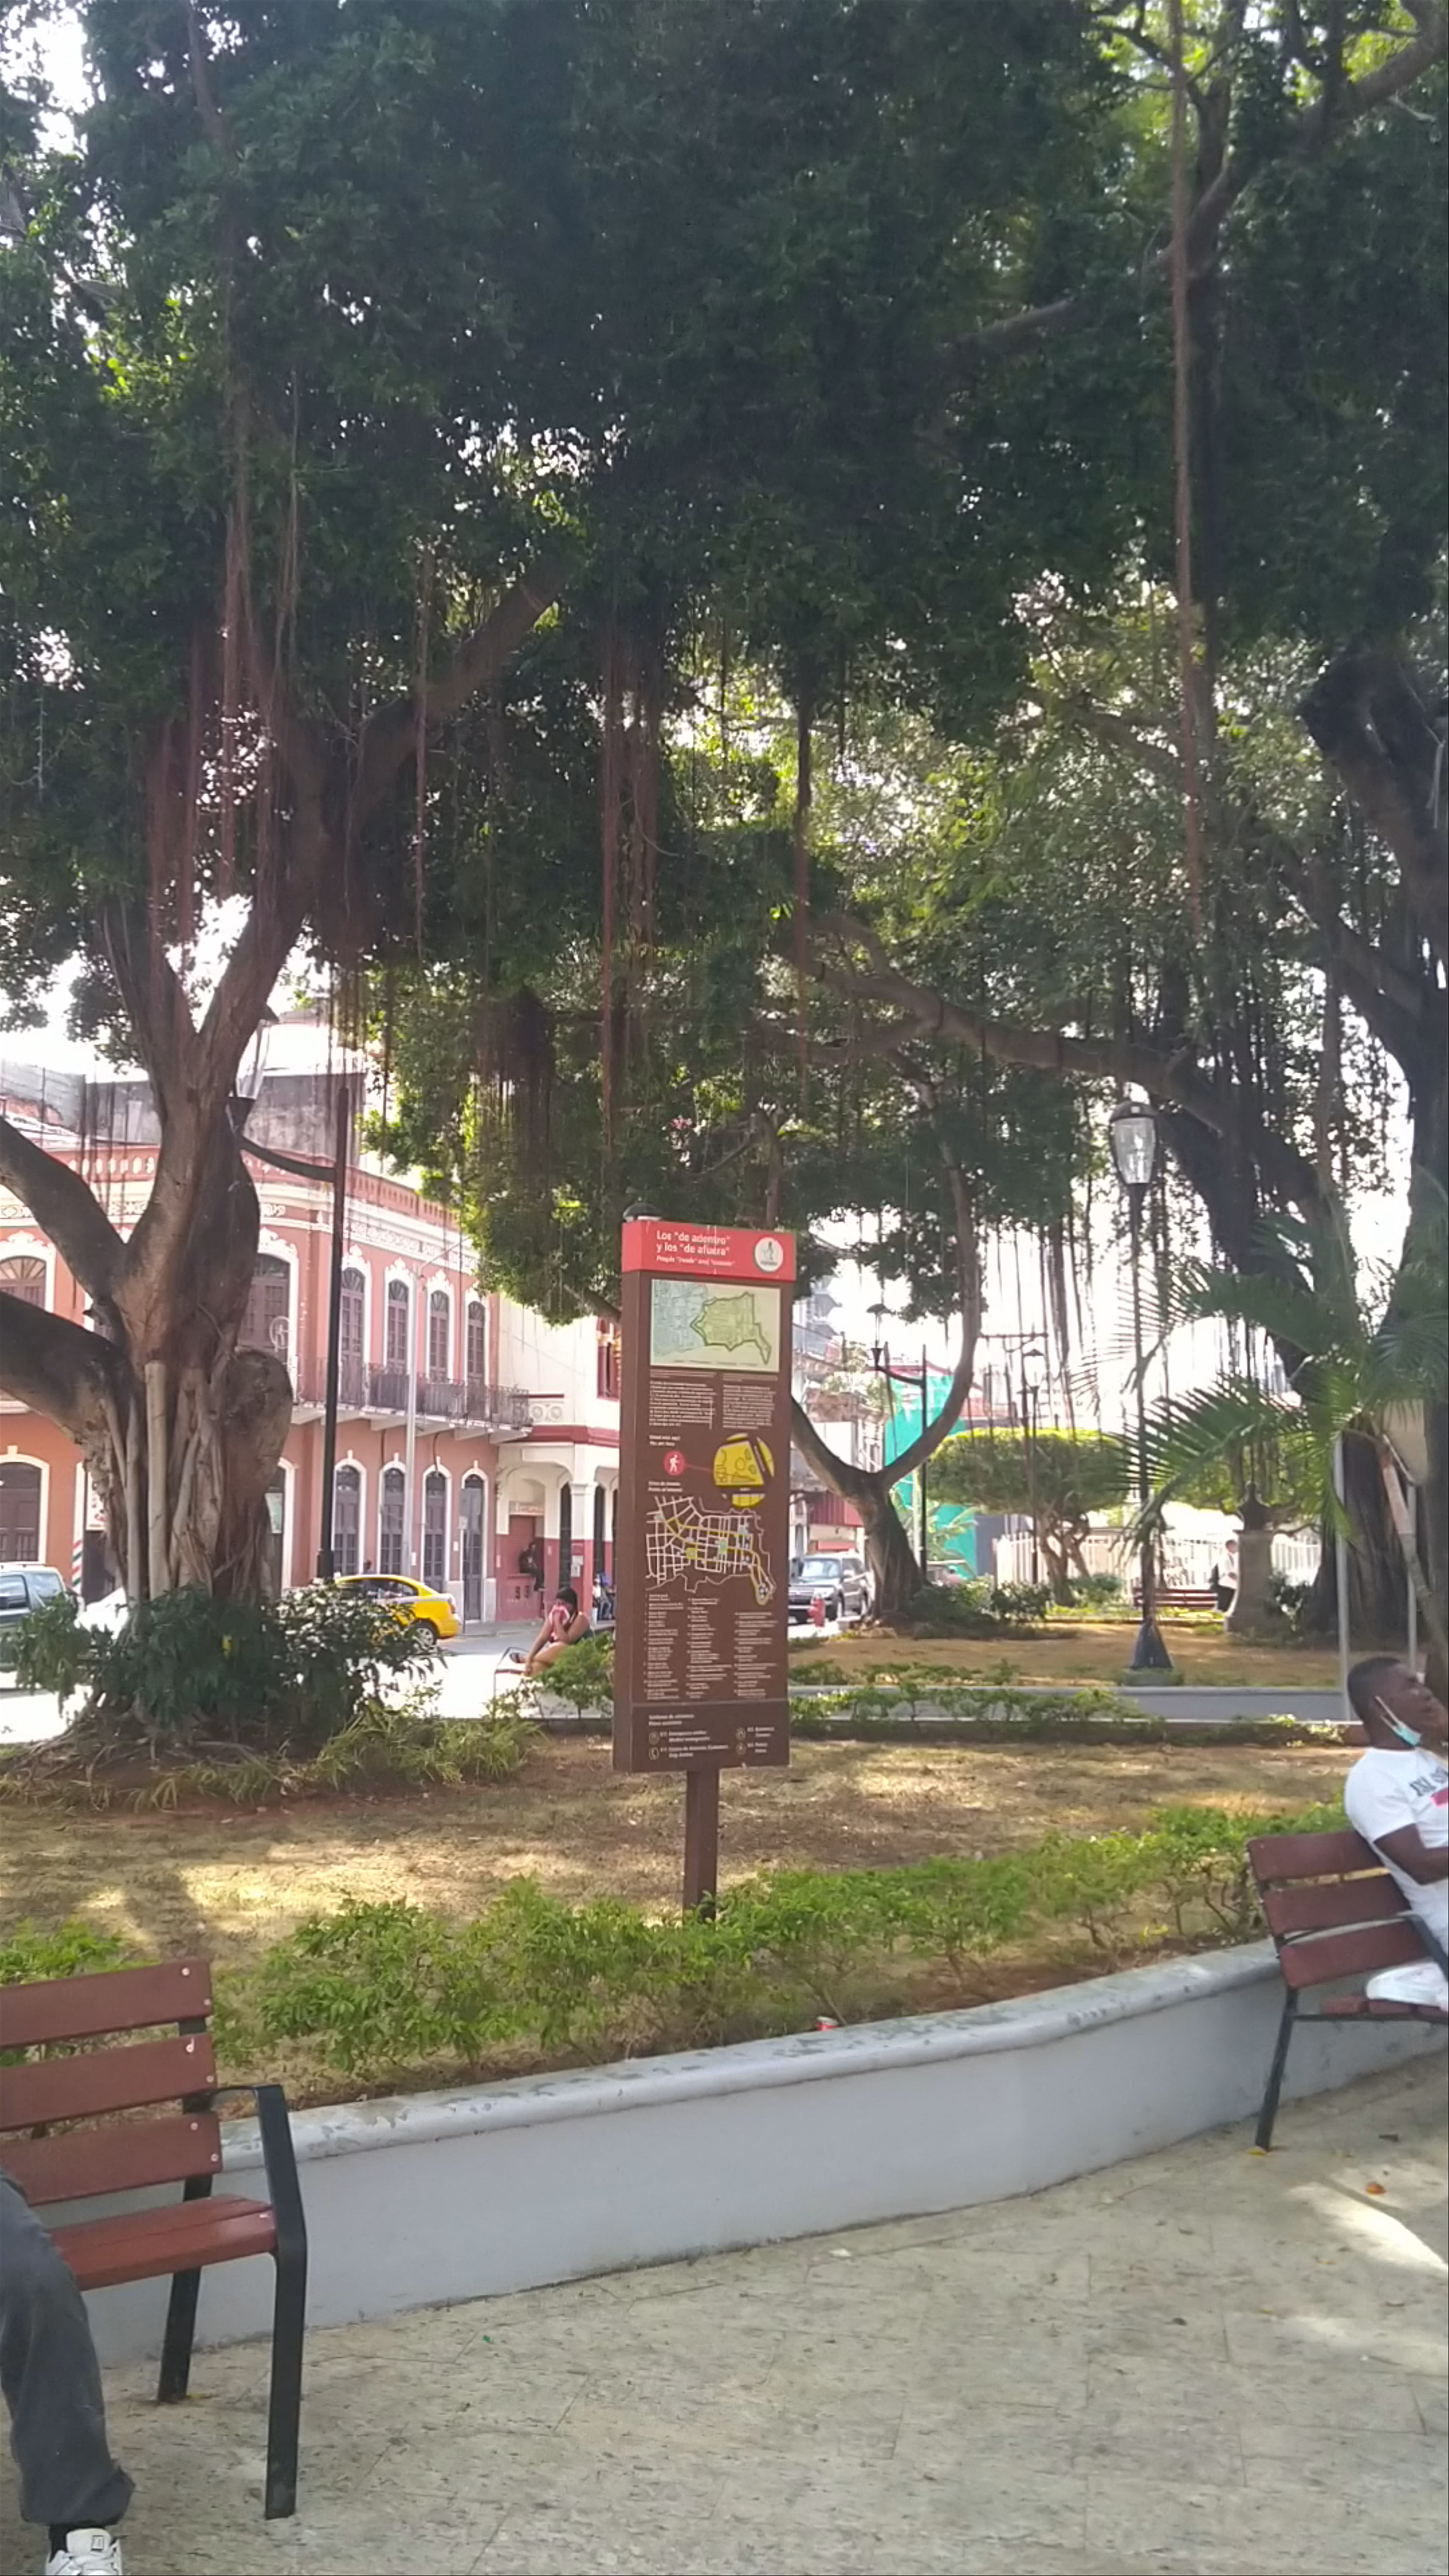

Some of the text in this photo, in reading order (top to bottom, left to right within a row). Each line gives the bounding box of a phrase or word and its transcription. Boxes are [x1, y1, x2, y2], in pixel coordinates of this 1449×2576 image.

[657, 1230, 671, 1241] Los
[657, 1243, 662, 1253] y
[665, 1242, 678, 1252] los
